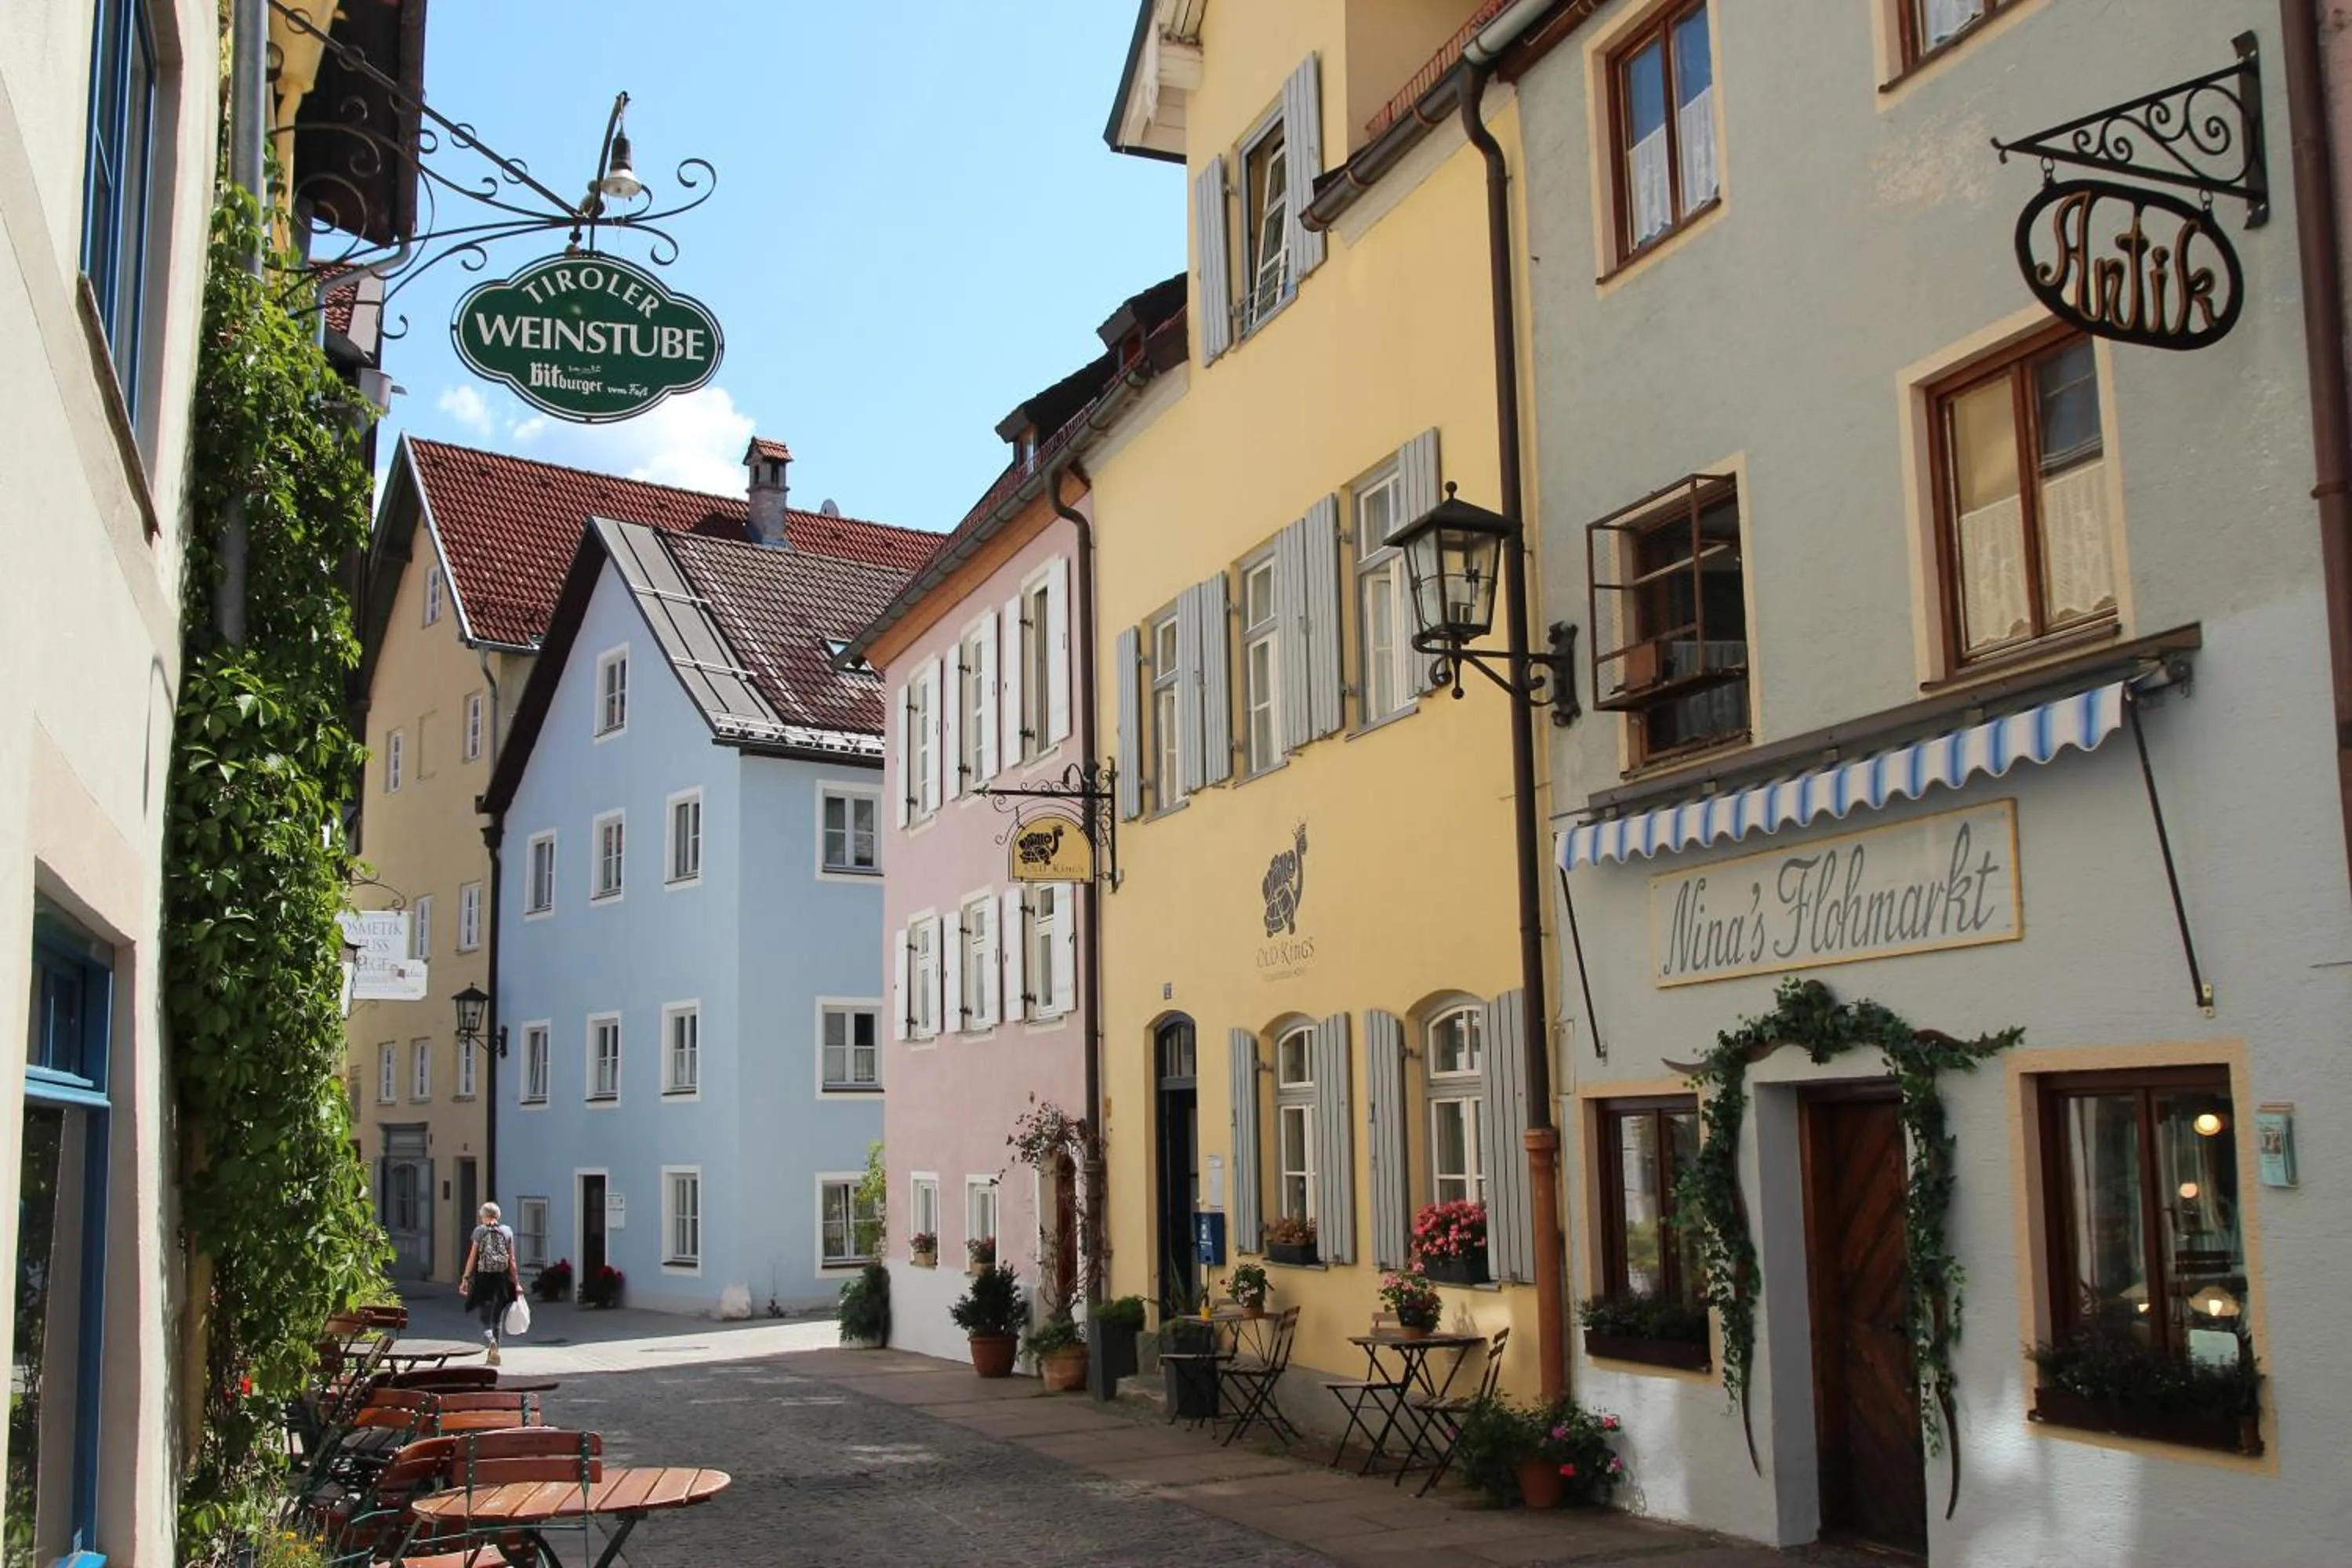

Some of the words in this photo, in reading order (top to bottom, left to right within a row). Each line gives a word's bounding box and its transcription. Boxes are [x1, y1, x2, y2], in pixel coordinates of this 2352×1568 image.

[2036, 191, 2218, 336] Antik
[521, 267, 660, 319] TIROLER
[474, 312, 705, 361] WEINSTUBE
[529, 361, 604, 395] Bitburger
[1663, 877, 1765, 977] Nina's
[1773, 821, 2000, 959] Flohmarkt
